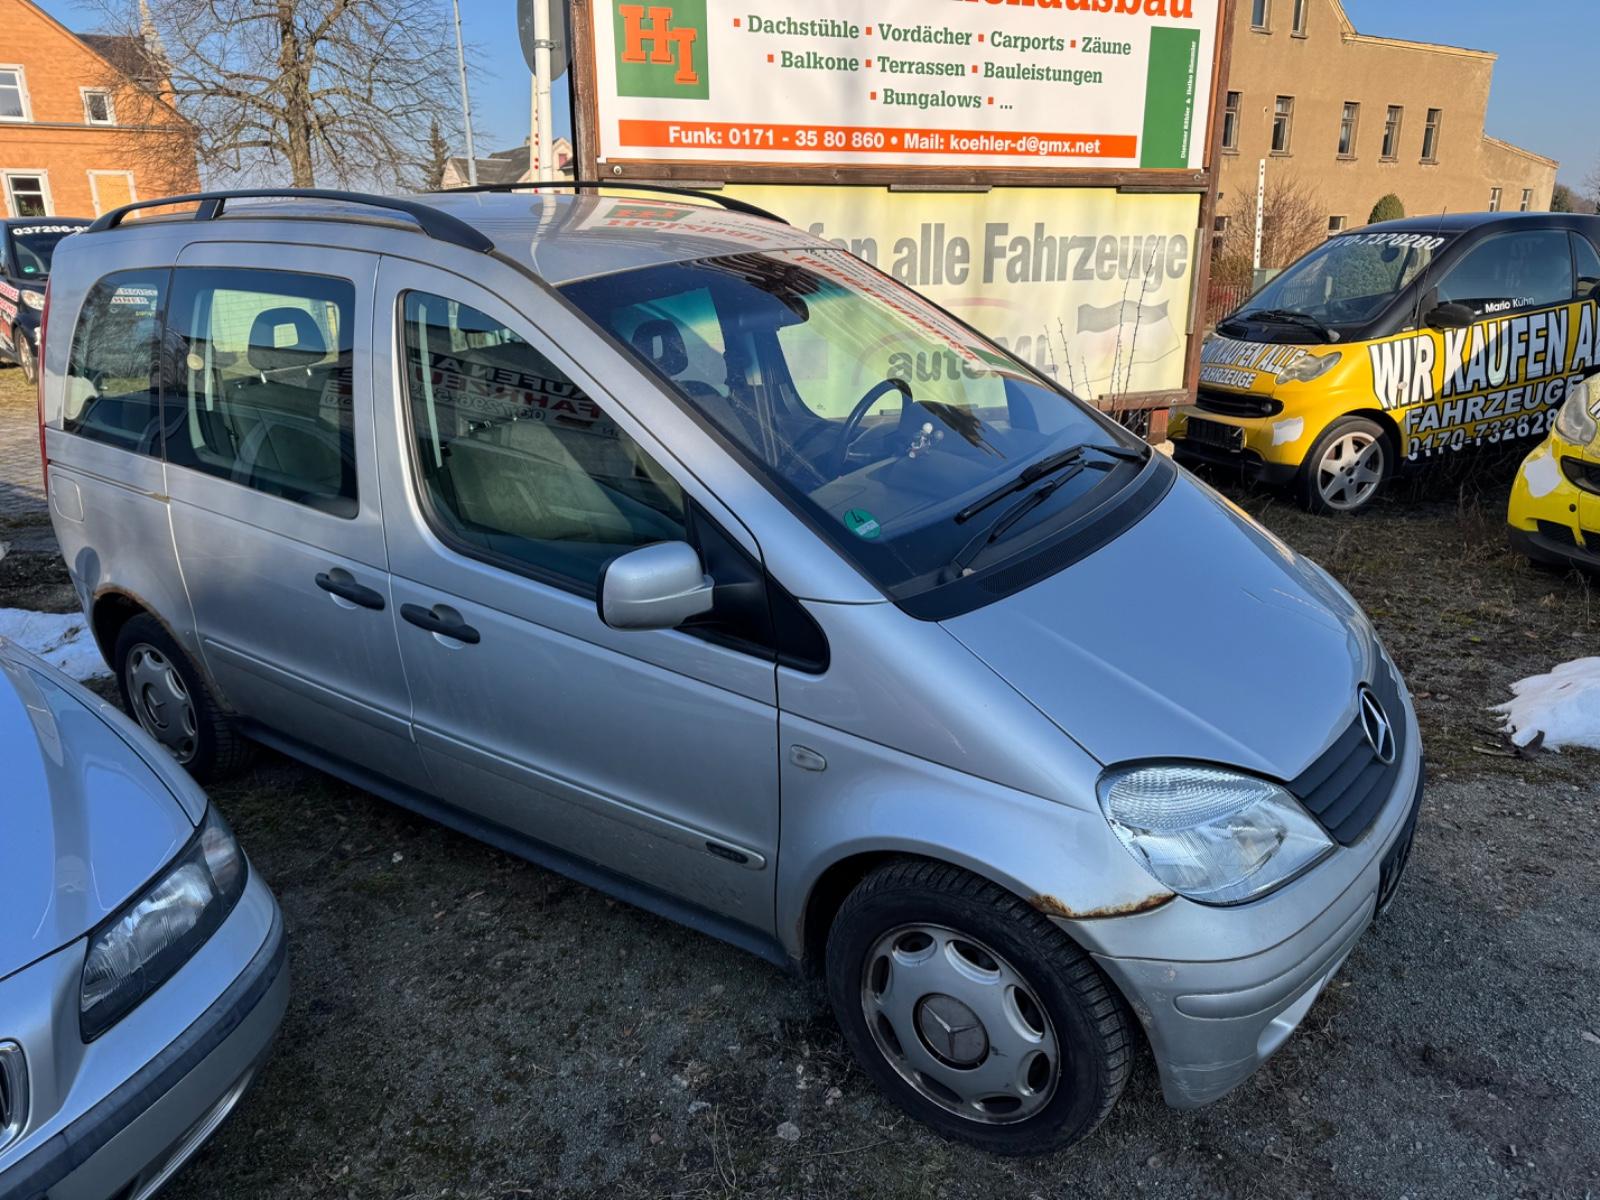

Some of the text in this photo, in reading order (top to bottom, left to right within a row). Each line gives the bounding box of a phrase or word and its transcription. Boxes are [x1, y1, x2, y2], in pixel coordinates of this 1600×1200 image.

[748, 15, 1132, 55] Dachstühle Vordächer Carports Zäune
[781, 50, 1103, 85] Balkone Terrassen Bauleistungen
[882, 88, 982, 110] Bungalows
[668, 126, 723, 144] Funk:
[729, 129, 774, 146] 0171
[795, 131, 818, 147] 35
[824, 132, 846, 147] 80
[851, 132, 885, 149] 860
[904, 133, 944, 150] Mail:
[950, 134, 1101, 155] koehler-d@gmx.net
[891, 223, 970, 286] alle
[983, 222, 1188, 293] Fahrzeuge
[1485, 302, 1511, 313] Mario
[1512, 297, 1535, 308] Kühn
[1368, 334, 1436, 410] WIR
[1442, 308, 1570, 396] KAUFEN
